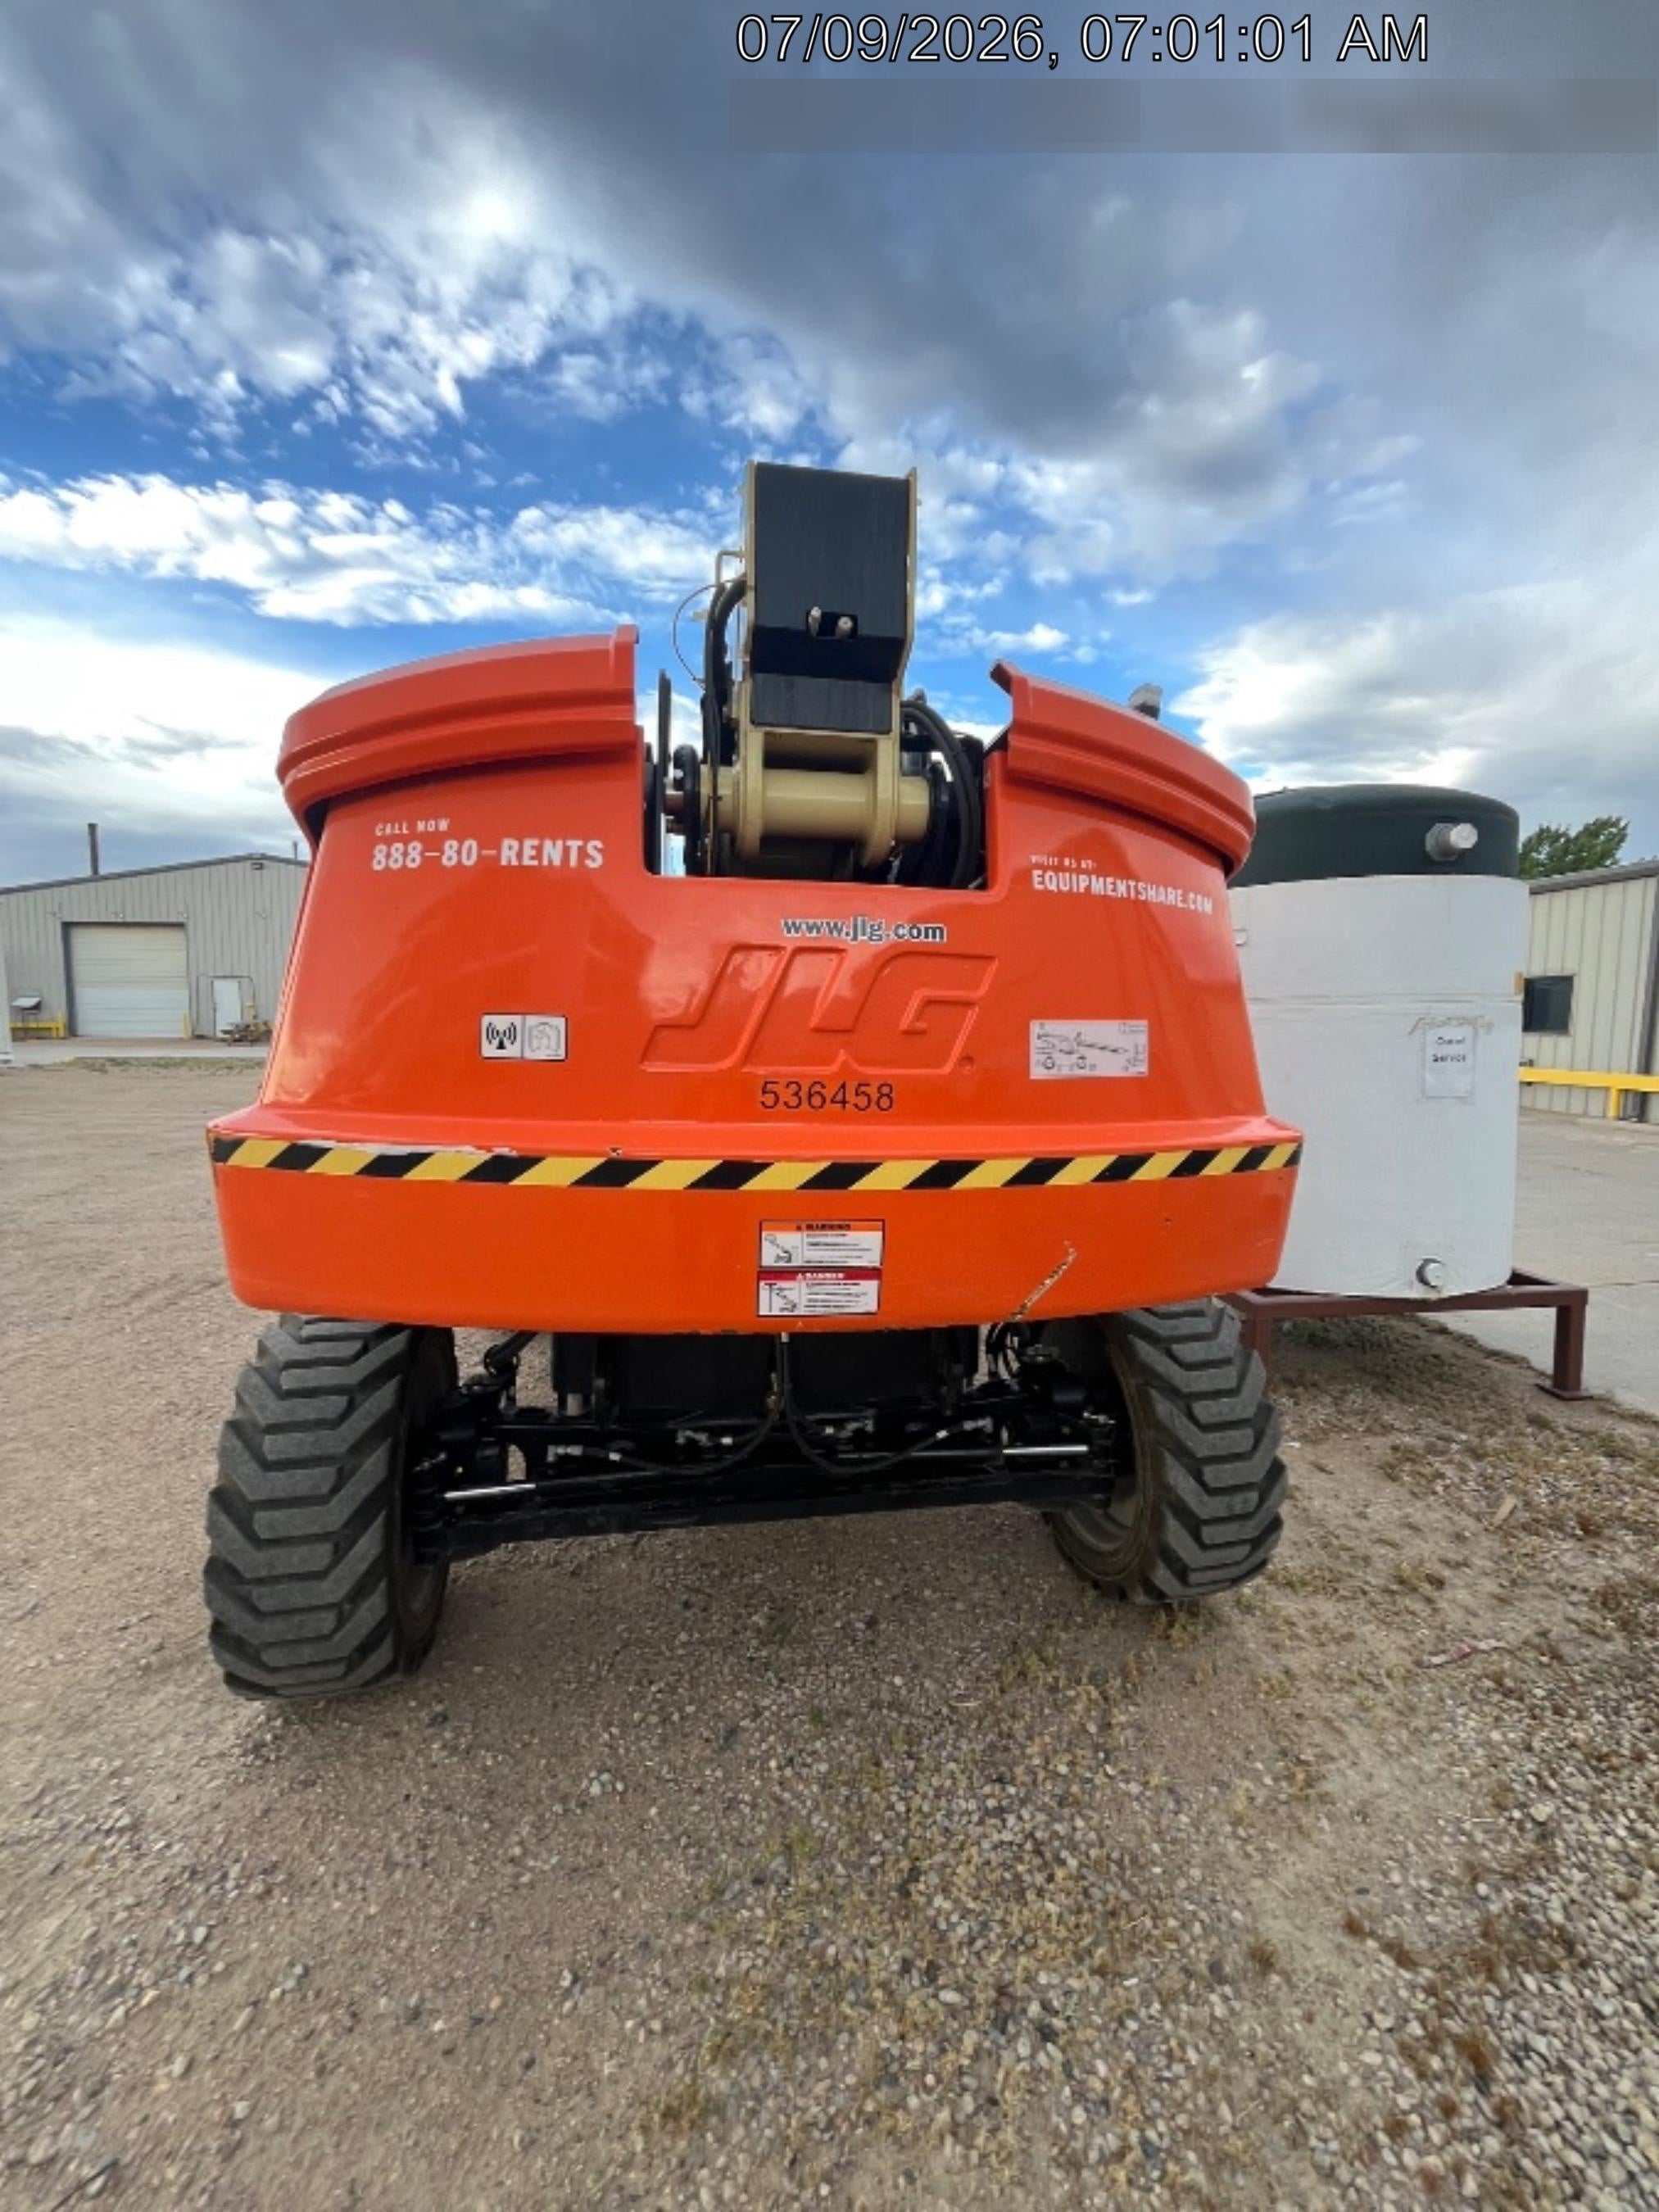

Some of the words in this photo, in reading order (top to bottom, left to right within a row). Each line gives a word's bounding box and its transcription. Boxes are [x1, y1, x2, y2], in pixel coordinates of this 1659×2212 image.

[375, 822, 410, 836] CALL
[416, 818, 451, 832] NOW
[372, 838, 604, 871] 888-80-RENTS
[1031, 869, 1213, 915] EQUIPMENTSHARE.COM
[782, 915, 947, 943] www.jlg.com
[641, 943, 999, 1076] JLG
[759, 1081, 895, 1113] 536458
